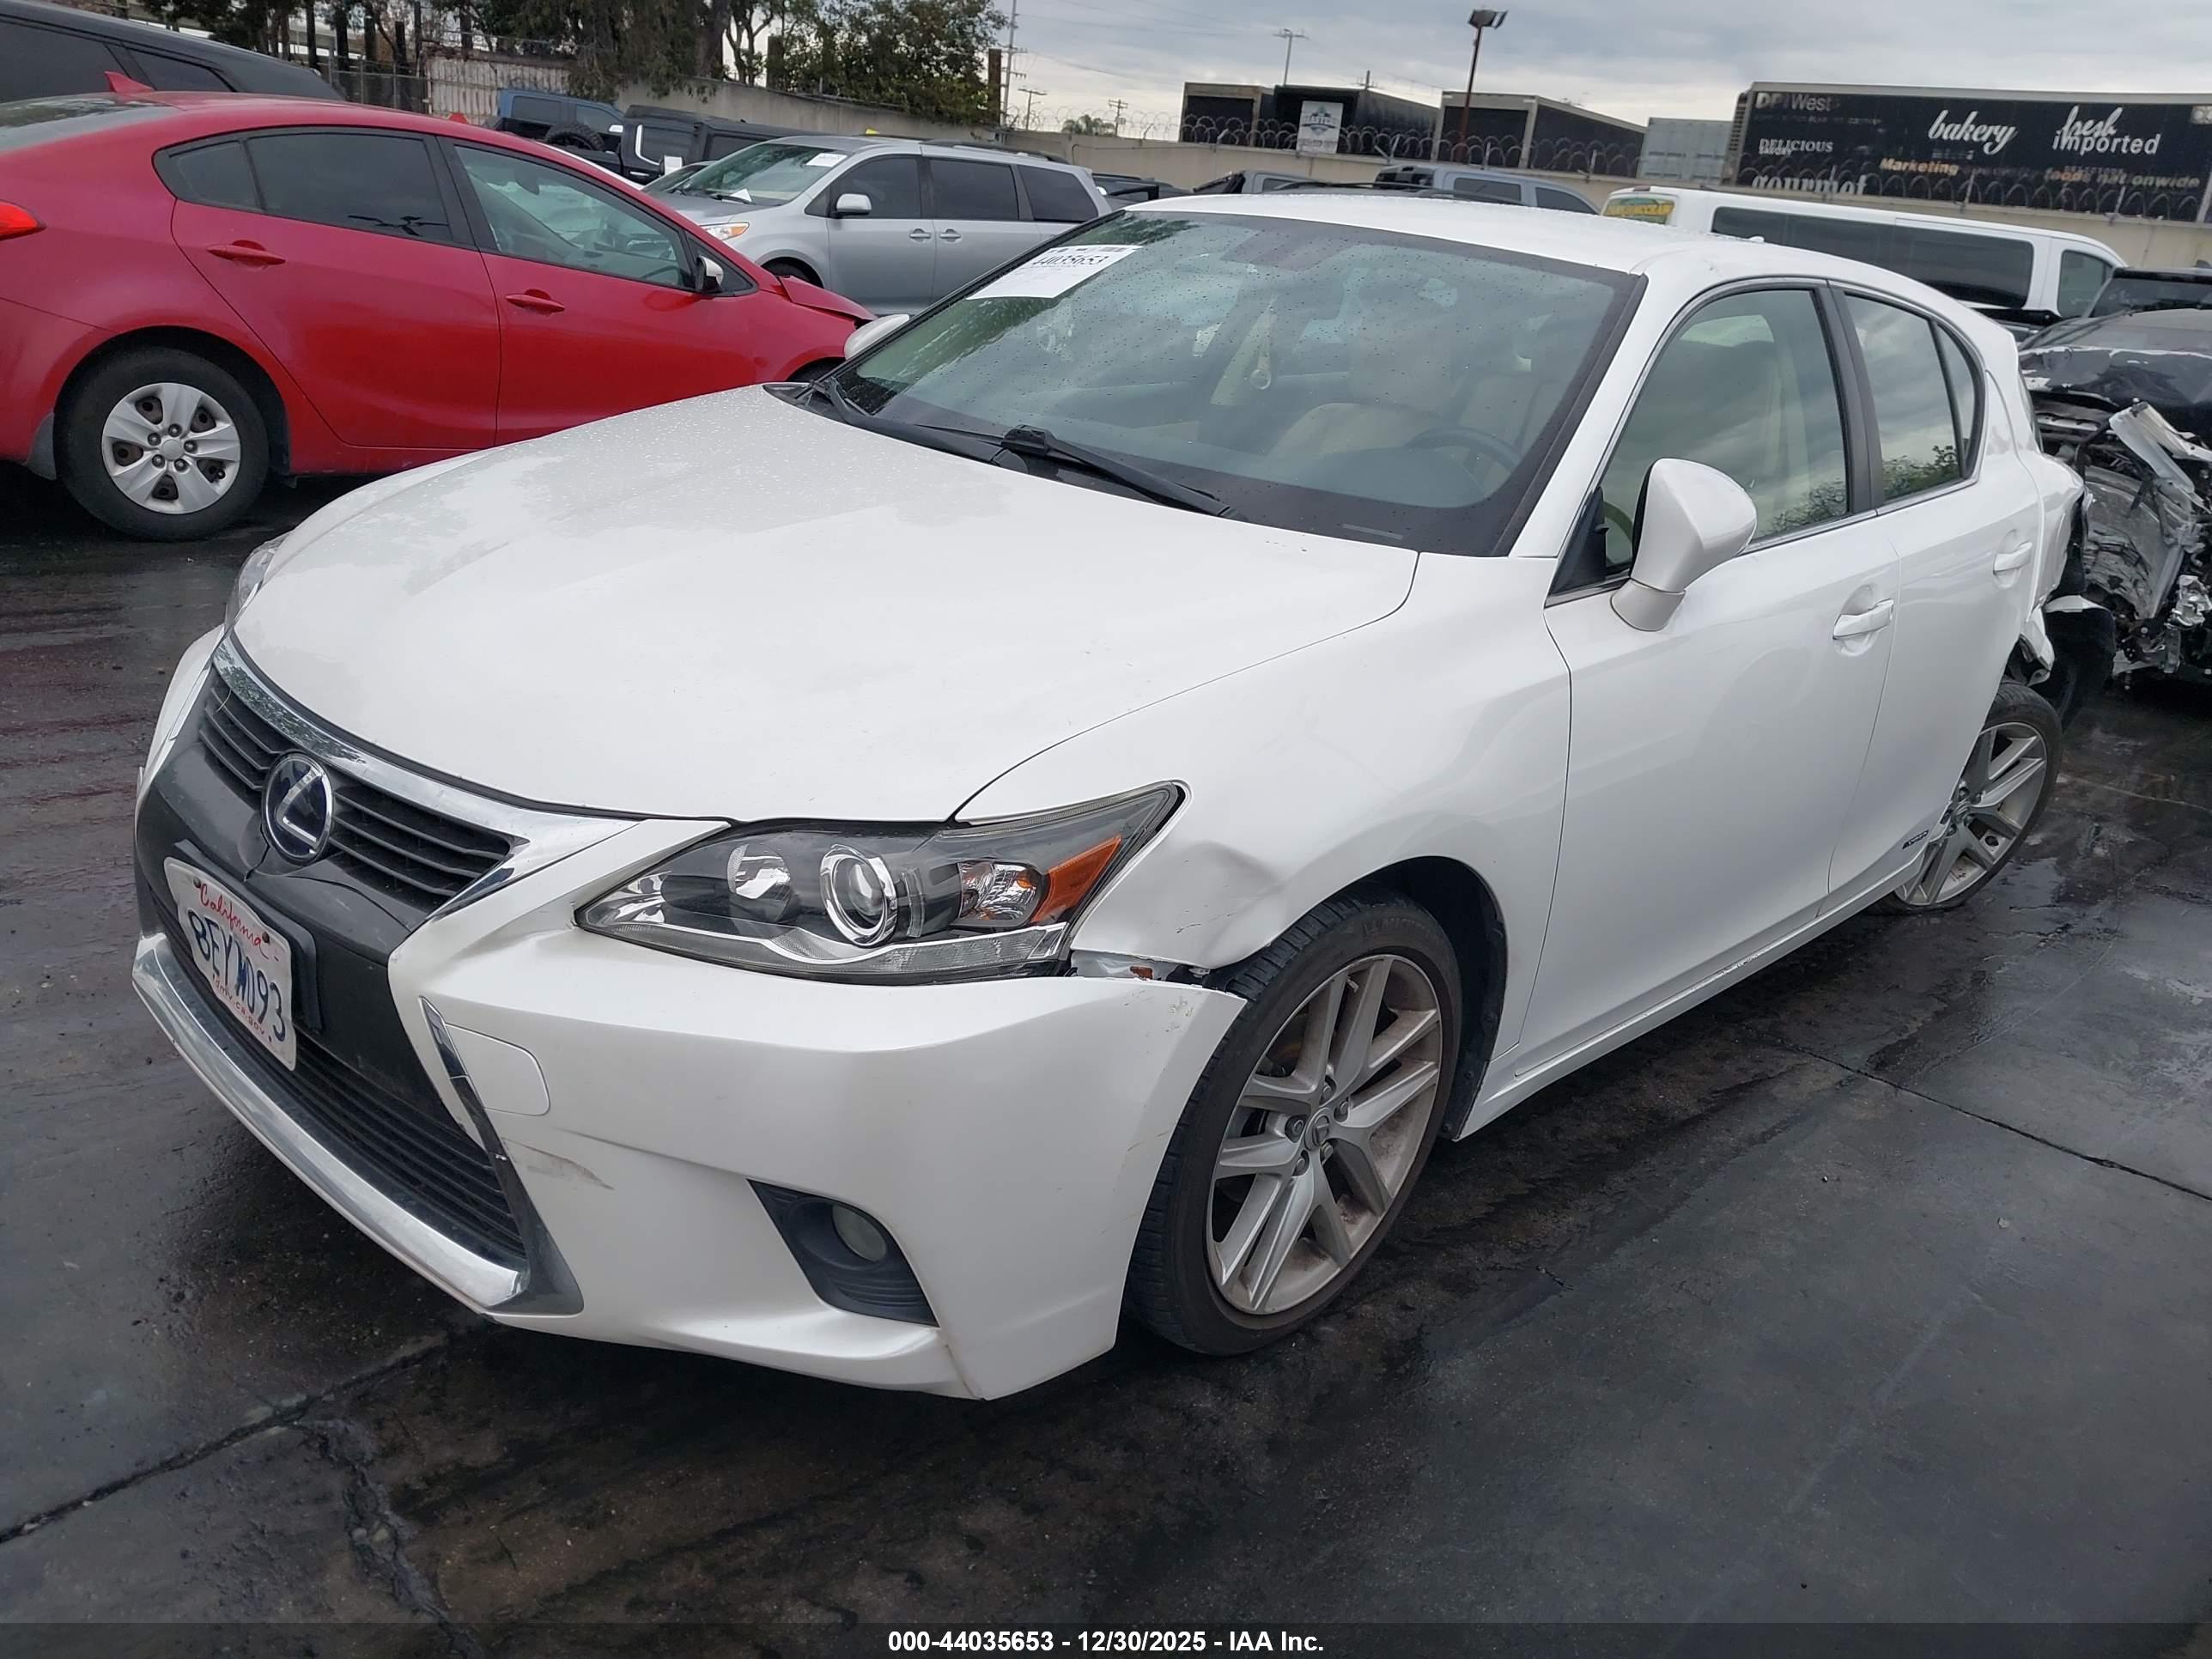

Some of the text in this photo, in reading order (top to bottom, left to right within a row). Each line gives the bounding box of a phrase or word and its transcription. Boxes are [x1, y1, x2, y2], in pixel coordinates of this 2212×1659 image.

[1928, 109, 2018, 155] bakery
[2052, 130, 2161, 156] imported
[1759, 138, 1834, 153] DELICIOUS
[1880, 157, 1960, 177] Marketing
[200, 883, 270, 960] California
